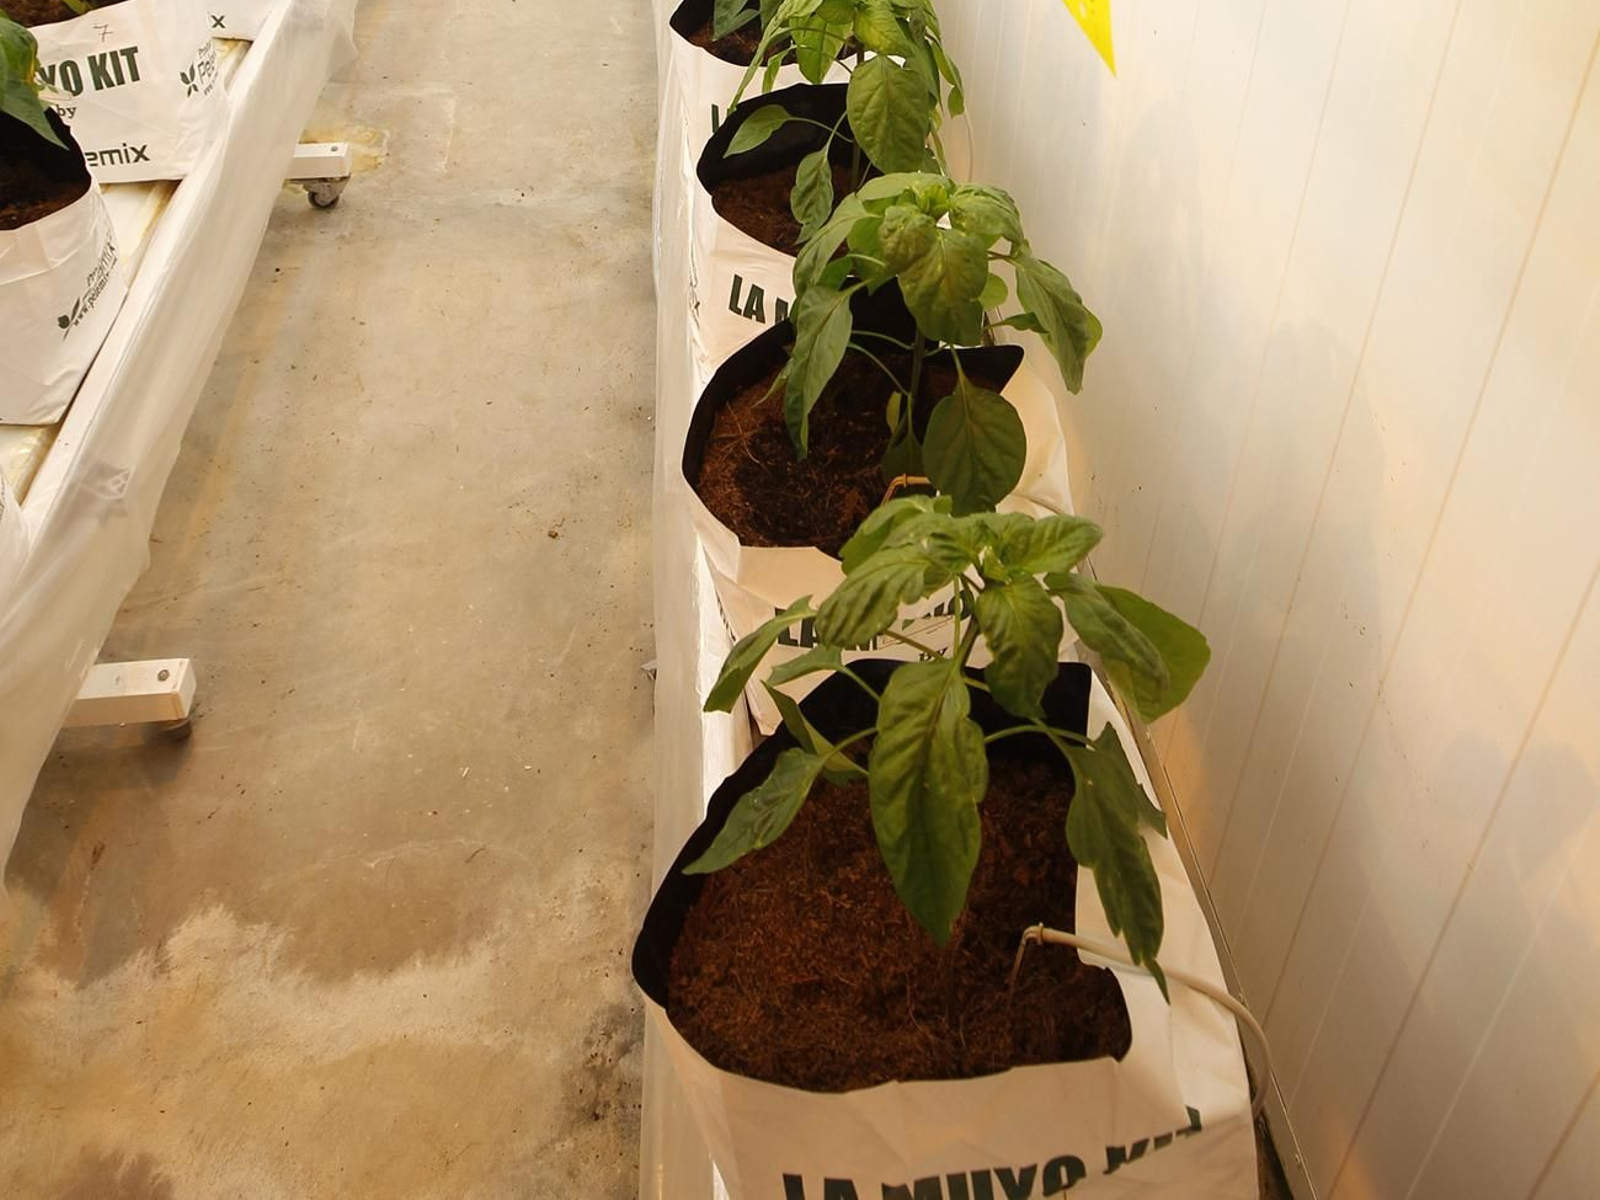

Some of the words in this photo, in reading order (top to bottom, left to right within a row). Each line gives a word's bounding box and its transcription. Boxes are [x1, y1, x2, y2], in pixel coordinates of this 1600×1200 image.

[93, 22, 114, 42] 7
[40, 60, 84, 97] YO
[87, 46, 140, 91] KIT
[56, 104, 77, 119] by
[84, 142, 151, 167] emix
[728, 274, 766, 324] LA
